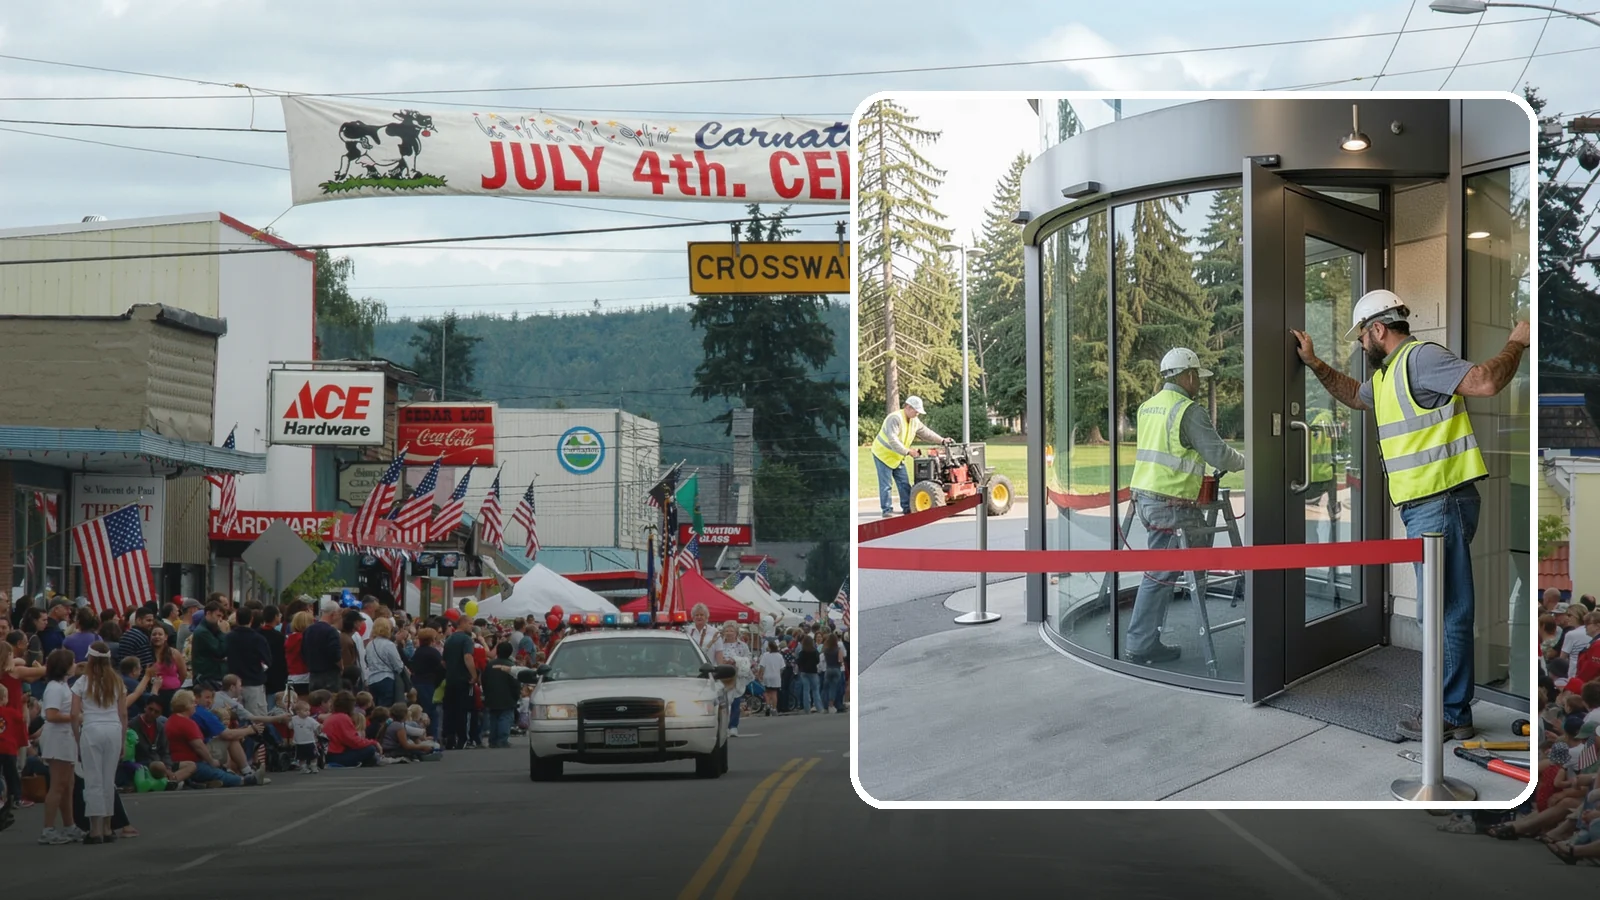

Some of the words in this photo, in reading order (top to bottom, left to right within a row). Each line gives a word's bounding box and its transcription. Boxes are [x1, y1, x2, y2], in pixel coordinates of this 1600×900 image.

[695, 121, 850, 150] Carnat
[481, 140, 605, 193] JULY
[632, 150, 746, 198] 4th.
[697, 254, 850, 280] CROSSWA
[282, 380, 374, 420] ACE
[405, 409, 452, 422] CEDAR
[283, 421, 371, 436] Hardware
[416, 428, 477, 447] Coca-Cola
[353, 467, 385, 480] Simpl
[95, 486, 124, 494] Vincent
[137, 486, 155, 495] Paul
[81, 503, 153, 522] THT
[213, 516, 331, 535] HARDARE
[688, 526, 741, 535] CRNATION
[699, 535, 730, 543] GLASS
